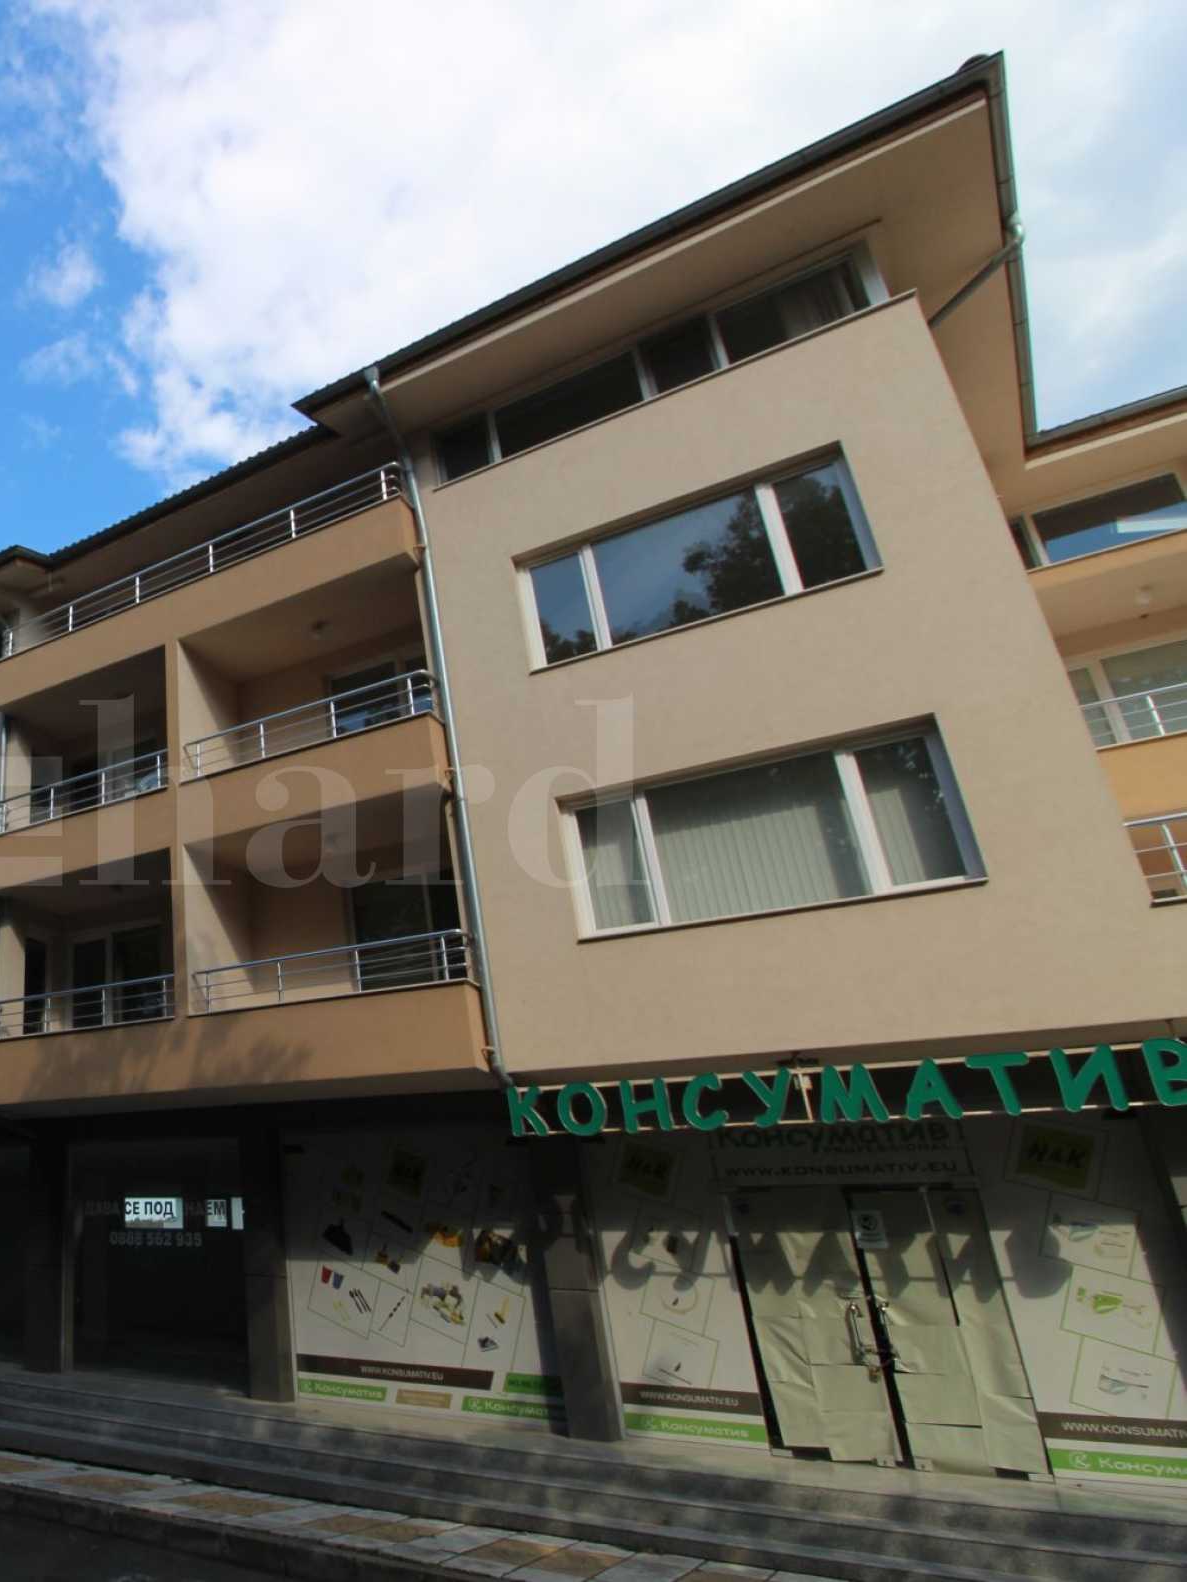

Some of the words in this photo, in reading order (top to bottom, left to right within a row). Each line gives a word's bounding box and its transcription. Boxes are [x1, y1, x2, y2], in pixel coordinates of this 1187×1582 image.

[507, 1036, 1187, 1138] КОНСУМАТИВ
[124, 1201, 140, 1215] СЕ
[144, 1201, 174, 1218] ПОД
[187, 1200, 227, 1216] НАЕМ
